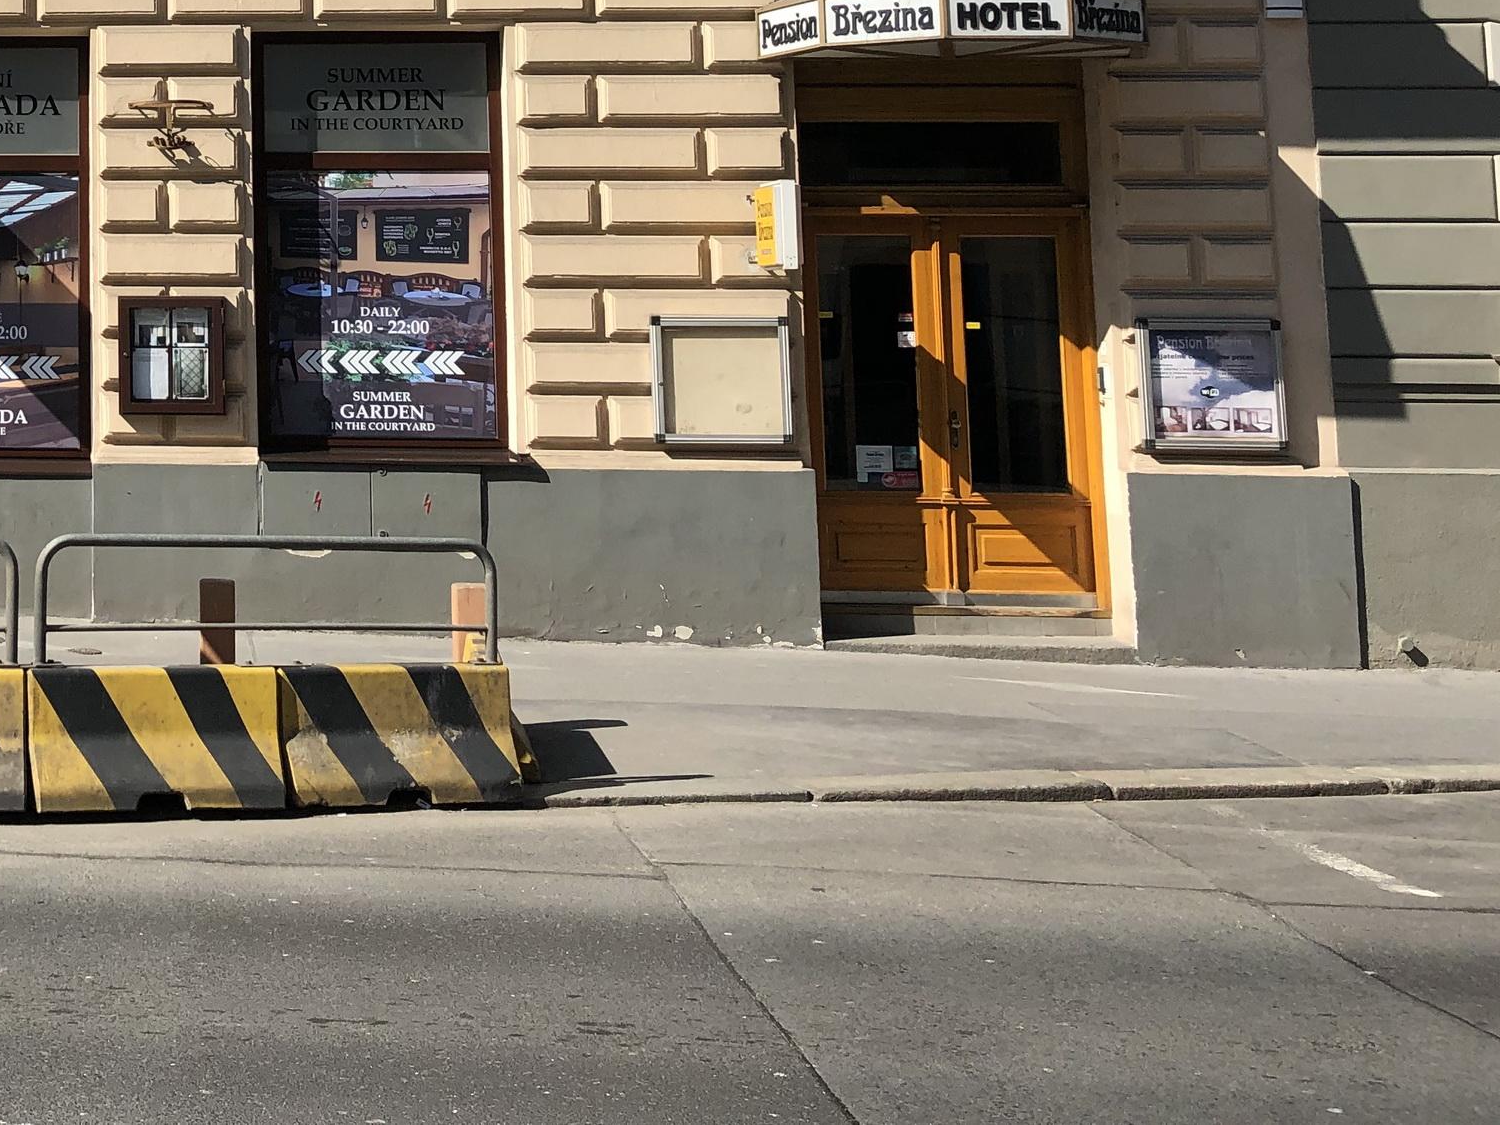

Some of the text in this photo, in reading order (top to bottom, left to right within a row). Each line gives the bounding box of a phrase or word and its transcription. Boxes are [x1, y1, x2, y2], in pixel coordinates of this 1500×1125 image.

[761, 14, 819, 49] Pension
[831, 3, 935, 36] Březina
[956, 1, 1062, 31] HOTEL
[327, 67, 424, 83] SUMMER
[306, 89, 446, 111] GARDEN
[291, 117, 464, 131] IN THE COURTYARD
[360, 306, 401, 317] DAILY
[331, 319, 373, 334] 10:30
[388, 320, 430, 334] 22:00
[353, 391, 412, 402] SUMMER
[340, 404, 425, 420] GARDEN
[331, 422, 436, 431] IN THE COURTYARD
